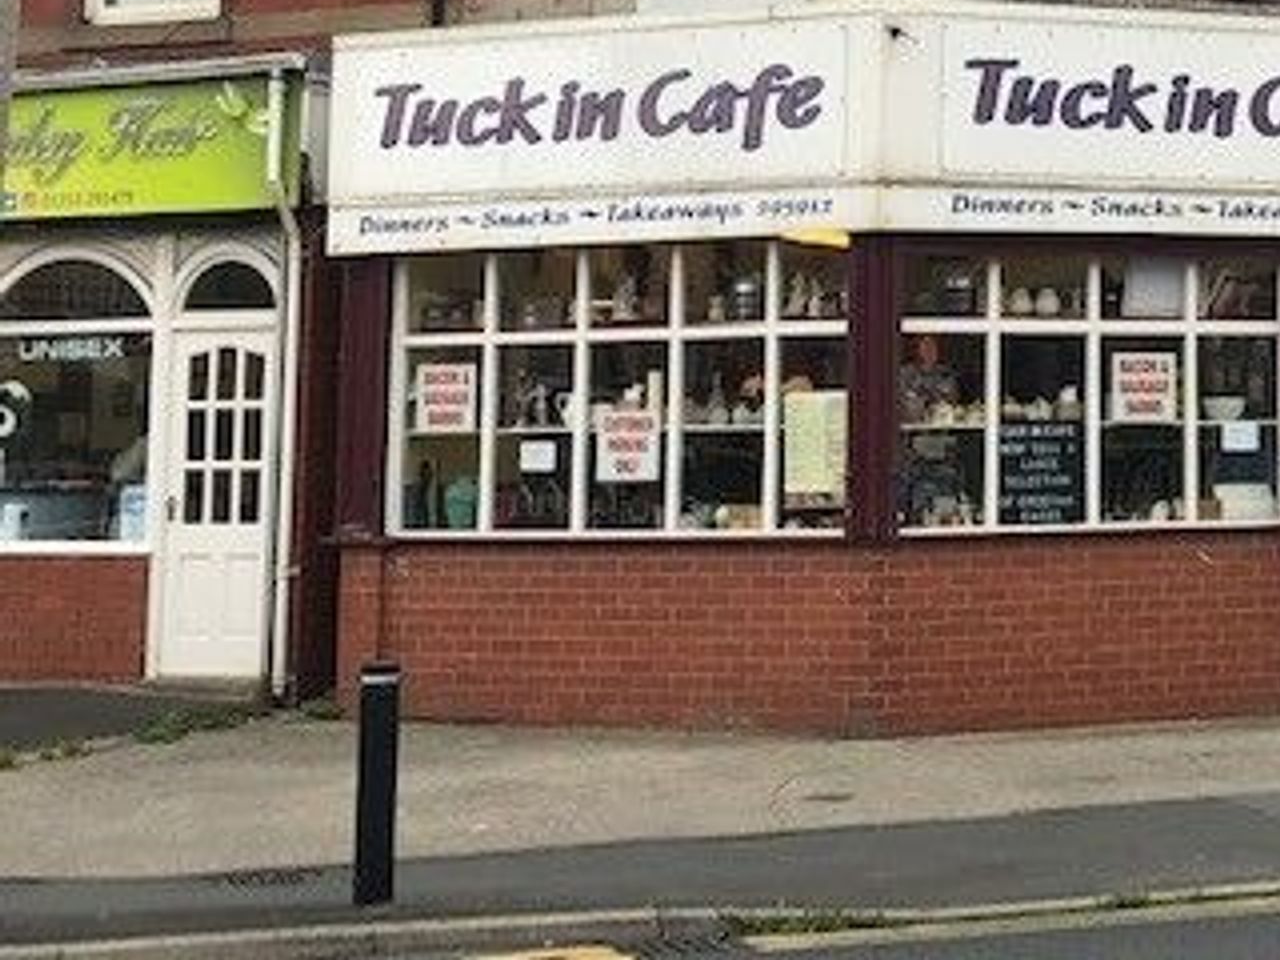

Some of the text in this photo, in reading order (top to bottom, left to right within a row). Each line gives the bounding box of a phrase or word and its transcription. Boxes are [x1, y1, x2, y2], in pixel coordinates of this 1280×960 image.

[374, 63, 825, 151] Tuck in Cafe
[964, 58, 1158, 133] Tuck
[1165, 74, 1240, 138] in
[359, 215, 450, 235] Dinners
[480, 207, 571, 229] Snacks
[607, 201, 745, 225] Takeaways
[951, 194, 1054, 214] Dinners
[1090, 195, 1183, 218] Snacks
[19, 338, 124, 361] UNISEX
